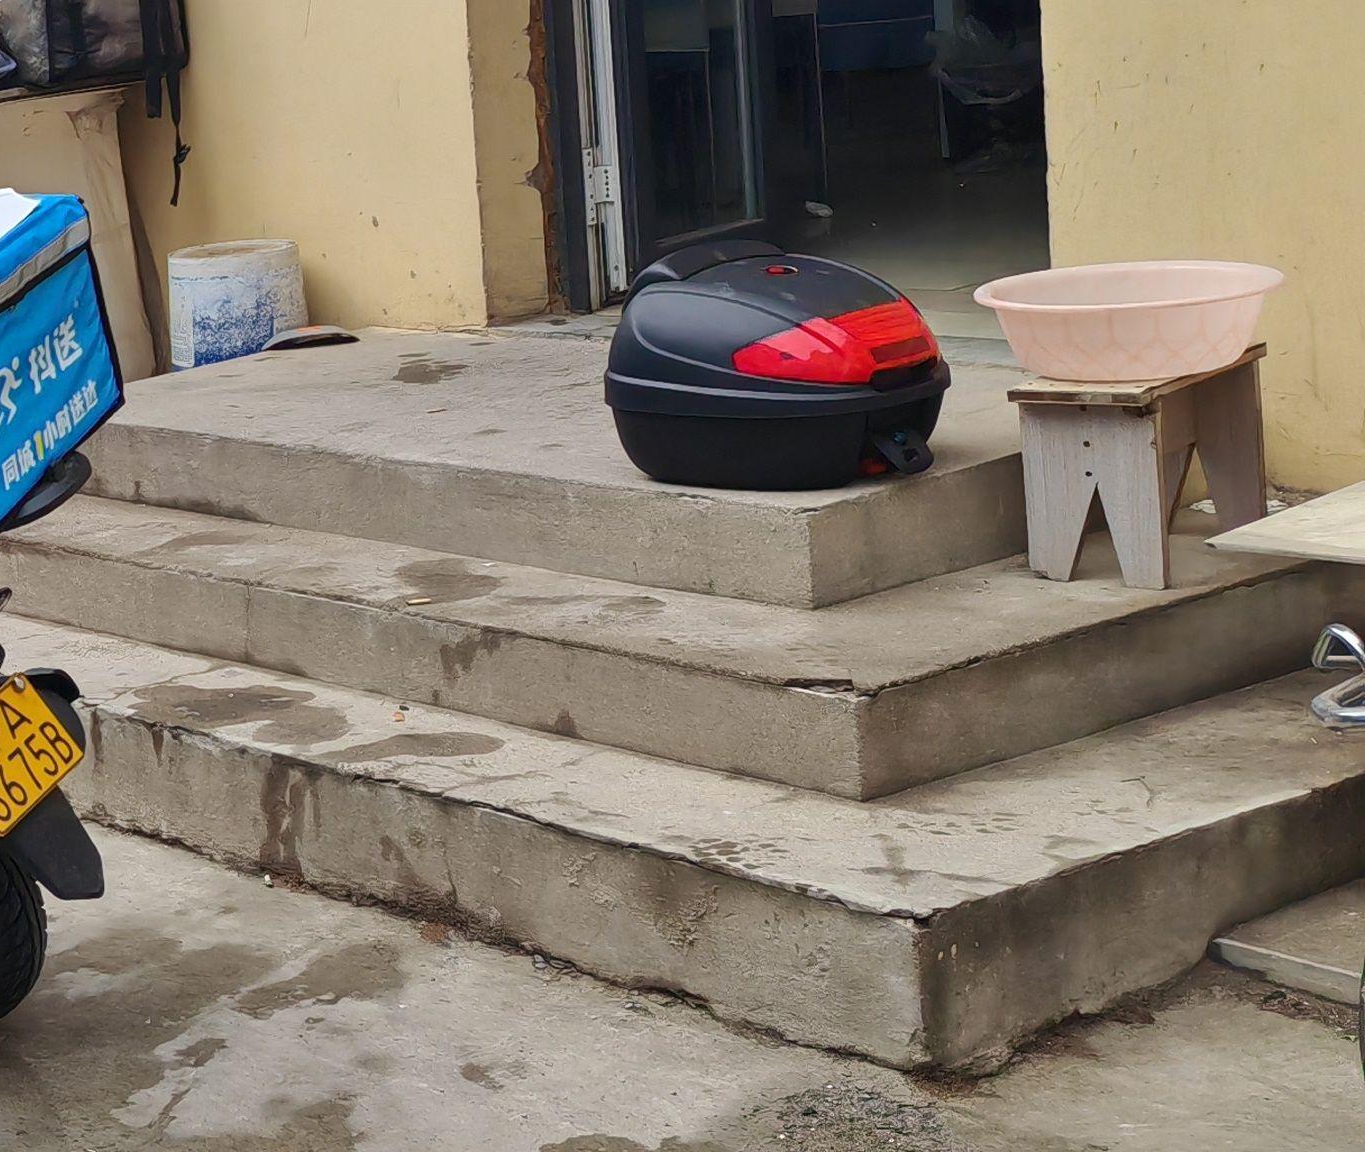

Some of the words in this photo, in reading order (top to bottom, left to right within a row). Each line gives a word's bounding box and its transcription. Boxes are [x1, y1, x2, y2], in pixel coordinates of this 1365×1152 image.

[29, 313, 83, 394] 抖送
[2, 379, 98, 491] 同城1小时送达
